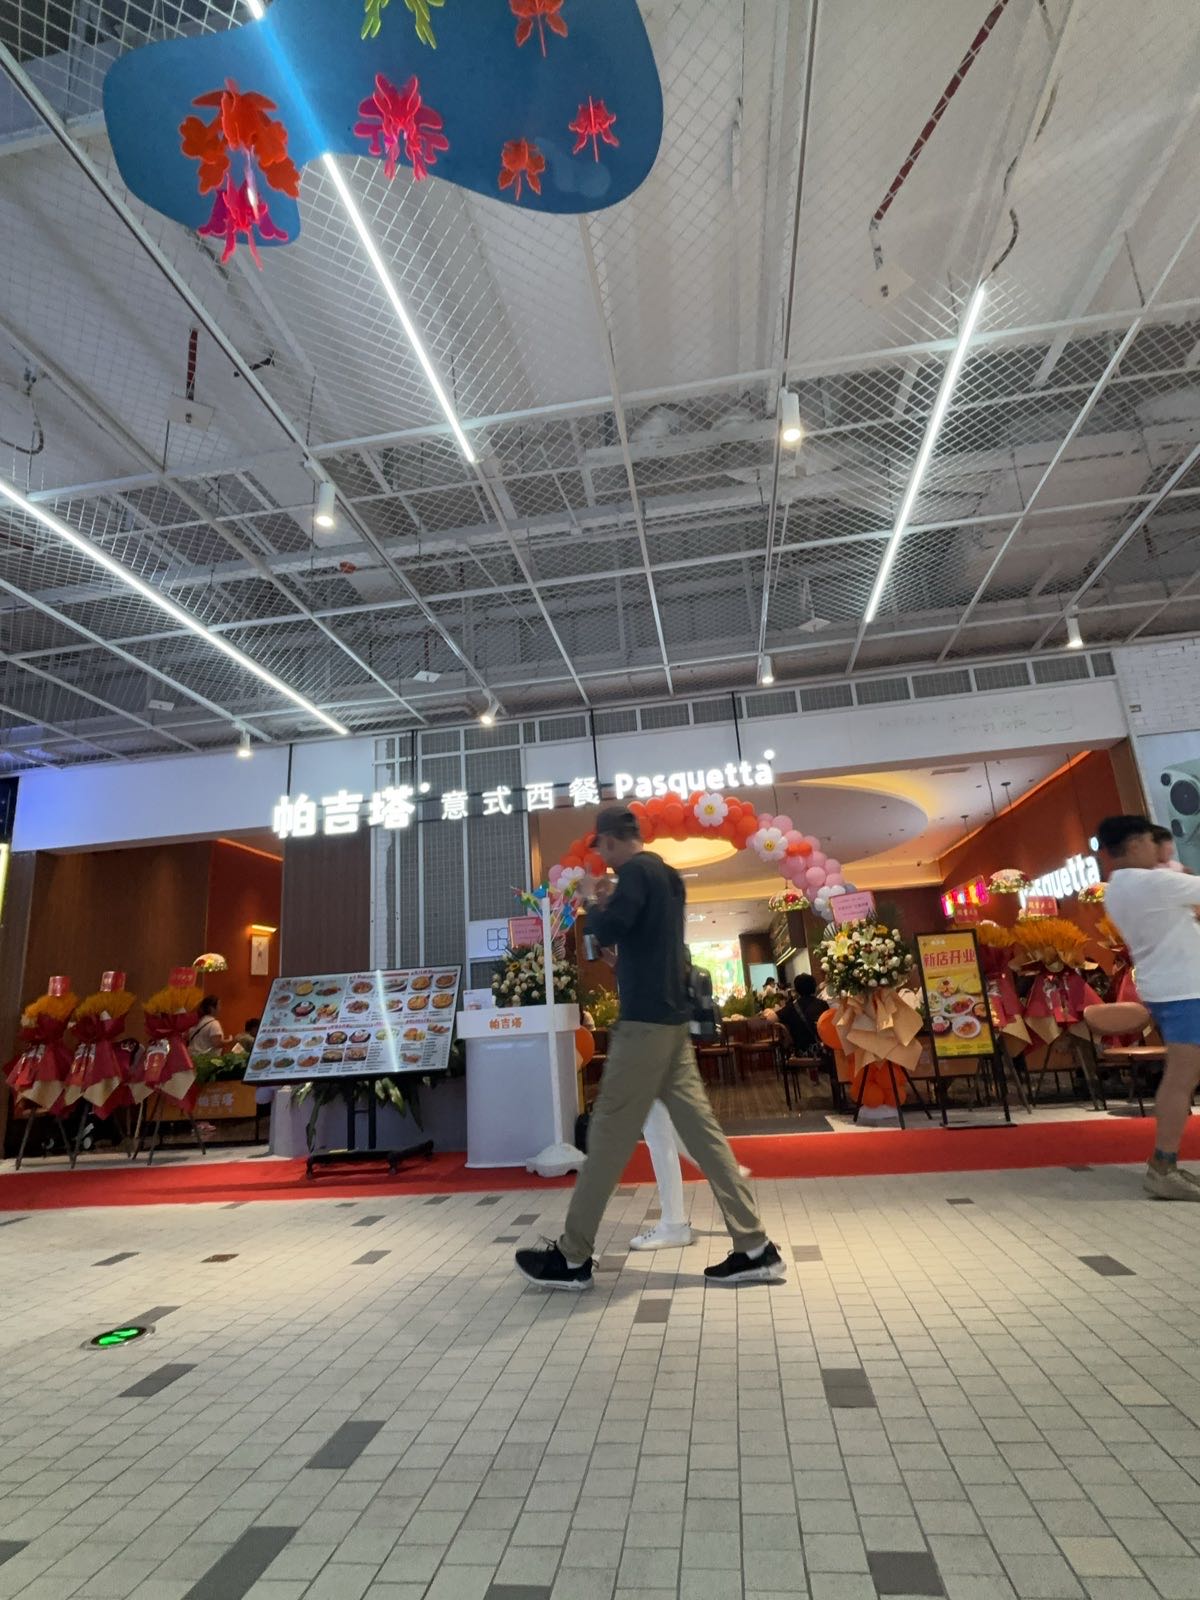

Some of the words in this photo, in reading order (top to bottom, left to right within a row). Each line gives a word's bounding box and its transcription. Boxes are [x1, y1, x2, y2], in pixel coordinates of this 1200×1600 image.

[272, 785, 416, 839] 帕吉塔
[441, 776, 600, 820] 意式西餐
[615, 760, 774, 800] Pasquetta
[923, 948, 976, 967] 新店开业
